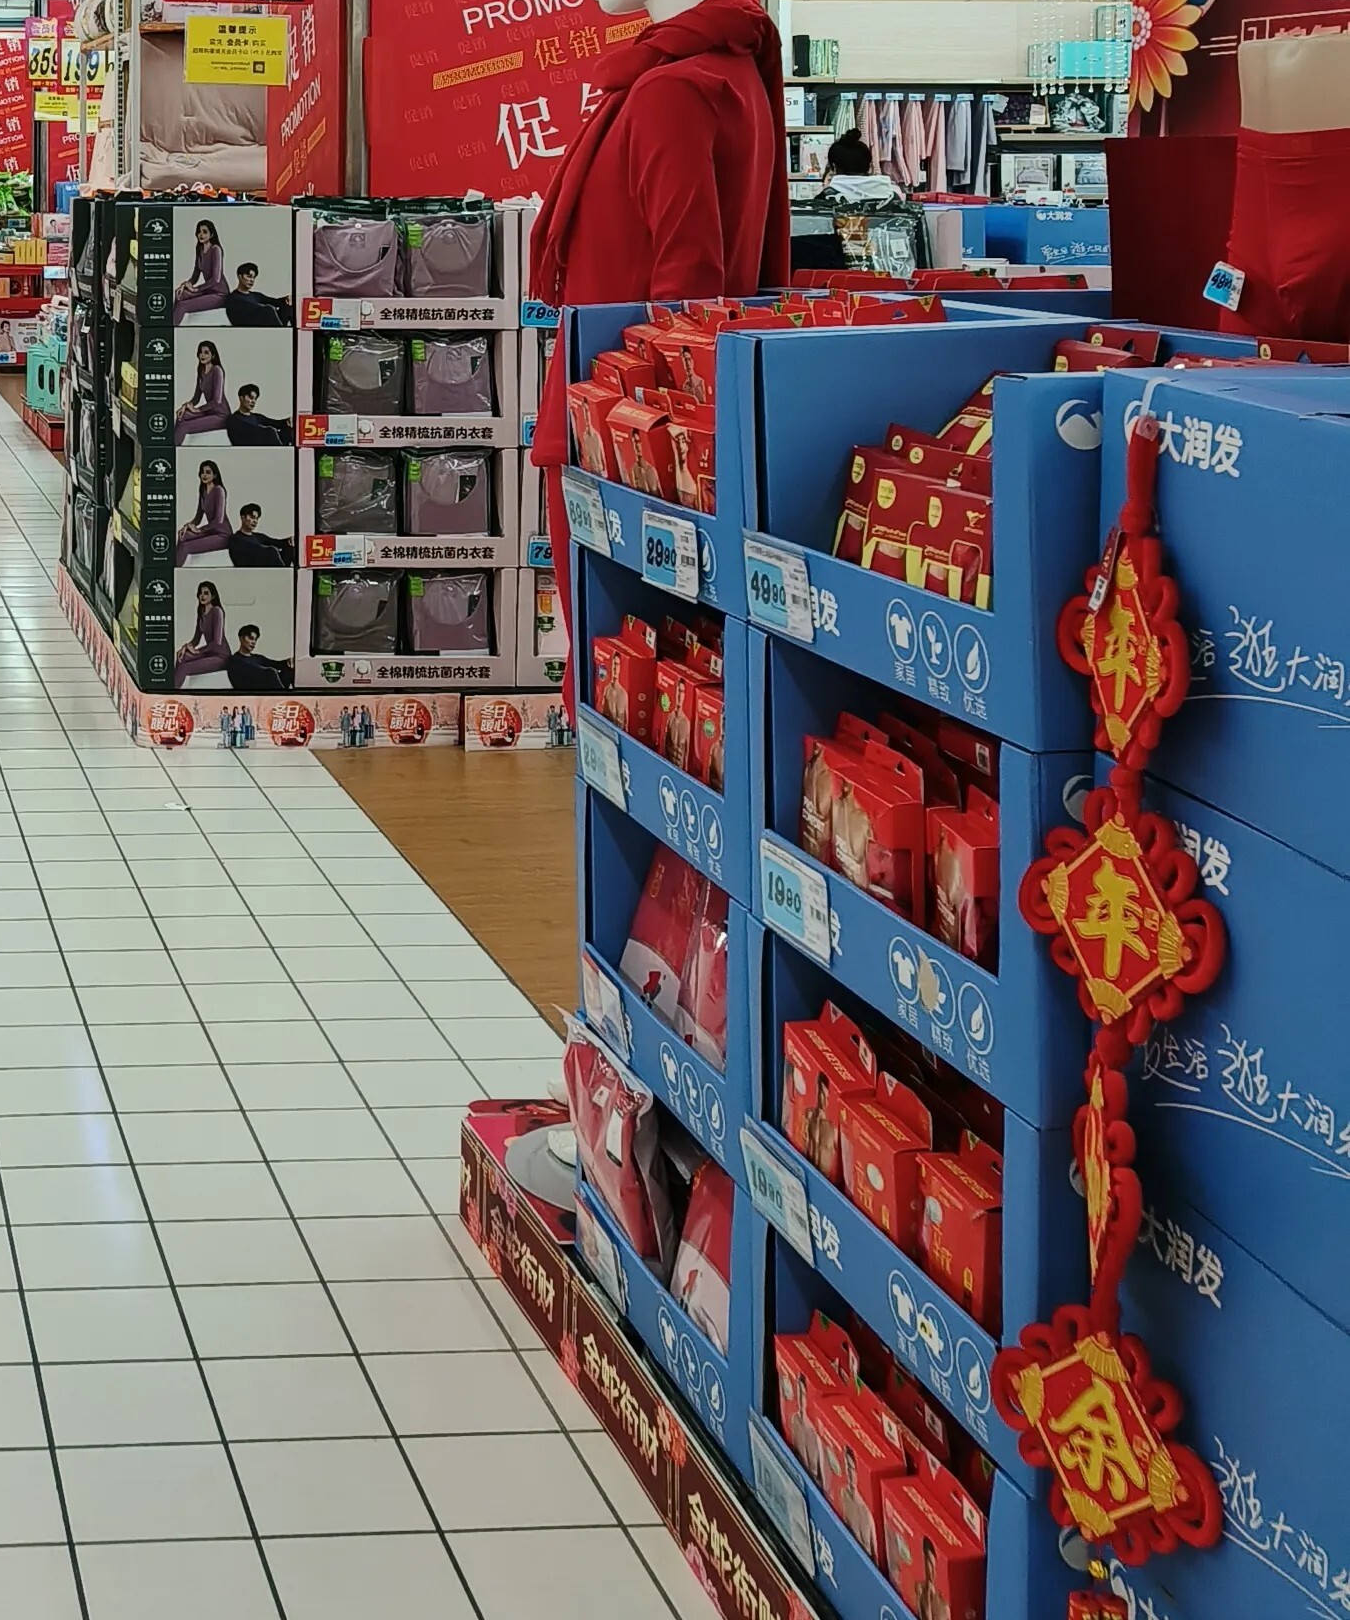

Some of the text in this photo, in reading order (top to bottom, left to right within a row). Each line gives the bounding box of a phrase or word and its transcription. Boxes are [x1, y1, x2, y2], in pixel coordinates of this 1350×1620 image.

[534, 26, 601, 71] 促销
[280, 74, 322, 147] PROMOTION
[380, 308, 495, 322] 全棉精梳抗菌内衣套
[379, 426, 494, 440] 全棉精梳抗菌内衣套
[1158, 411, 1243, 478] 大润发
[380, 546, 495, 560] 全棉精梳抗菌内衣套
[1225, 605, 1350, 708] 逛大润
[377, 666, 491, 680] 全棉精梳抗菌内衣套
[151, 703, 178, 718] 冬日
[272, 704, 299, 718] 冬日
[390, 703, 417, 718] 冬日
[480, 703, 507, 718] 冬日
[583, 1332, 659, 1476] 金蛇衔财
